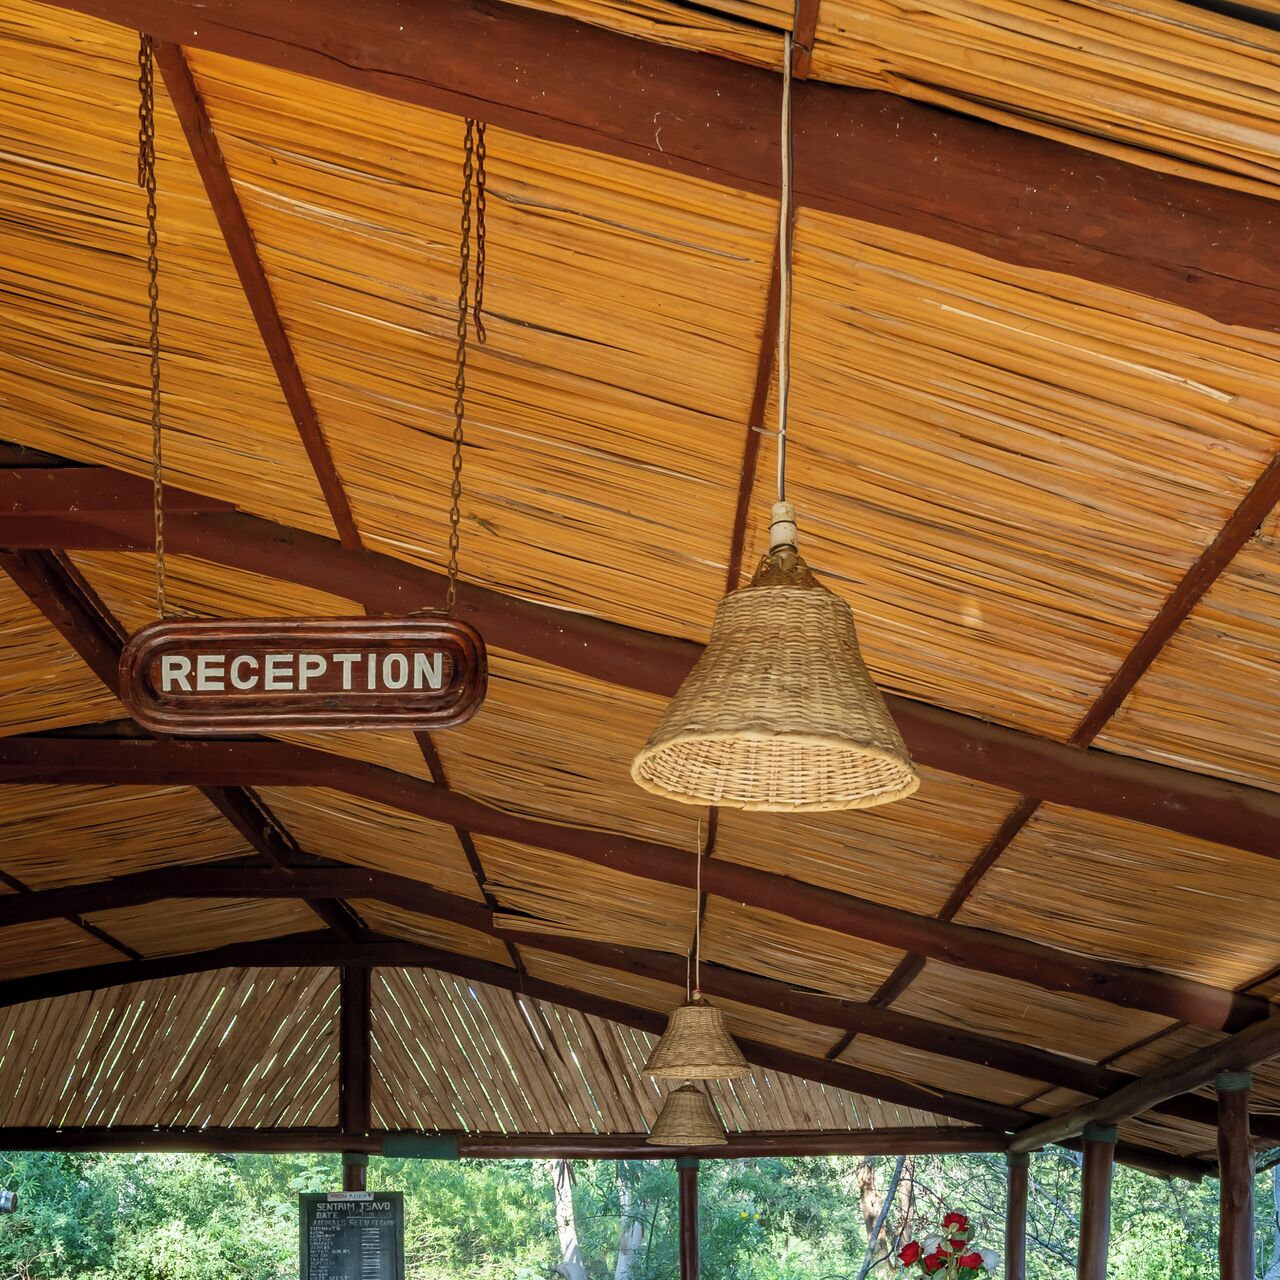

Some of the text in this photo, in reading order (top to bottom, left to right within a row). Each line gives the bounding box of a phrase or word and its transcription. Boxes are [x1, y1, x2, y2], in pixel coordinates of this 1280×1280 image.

[161, 652, 443, 692] RECEPTION
[316, 1202, 391, 1211] SENTRIM TSAVO
[316, 1211, 339, 1219] DATE
[313, 1219, 347, 1227] ANIMALS
